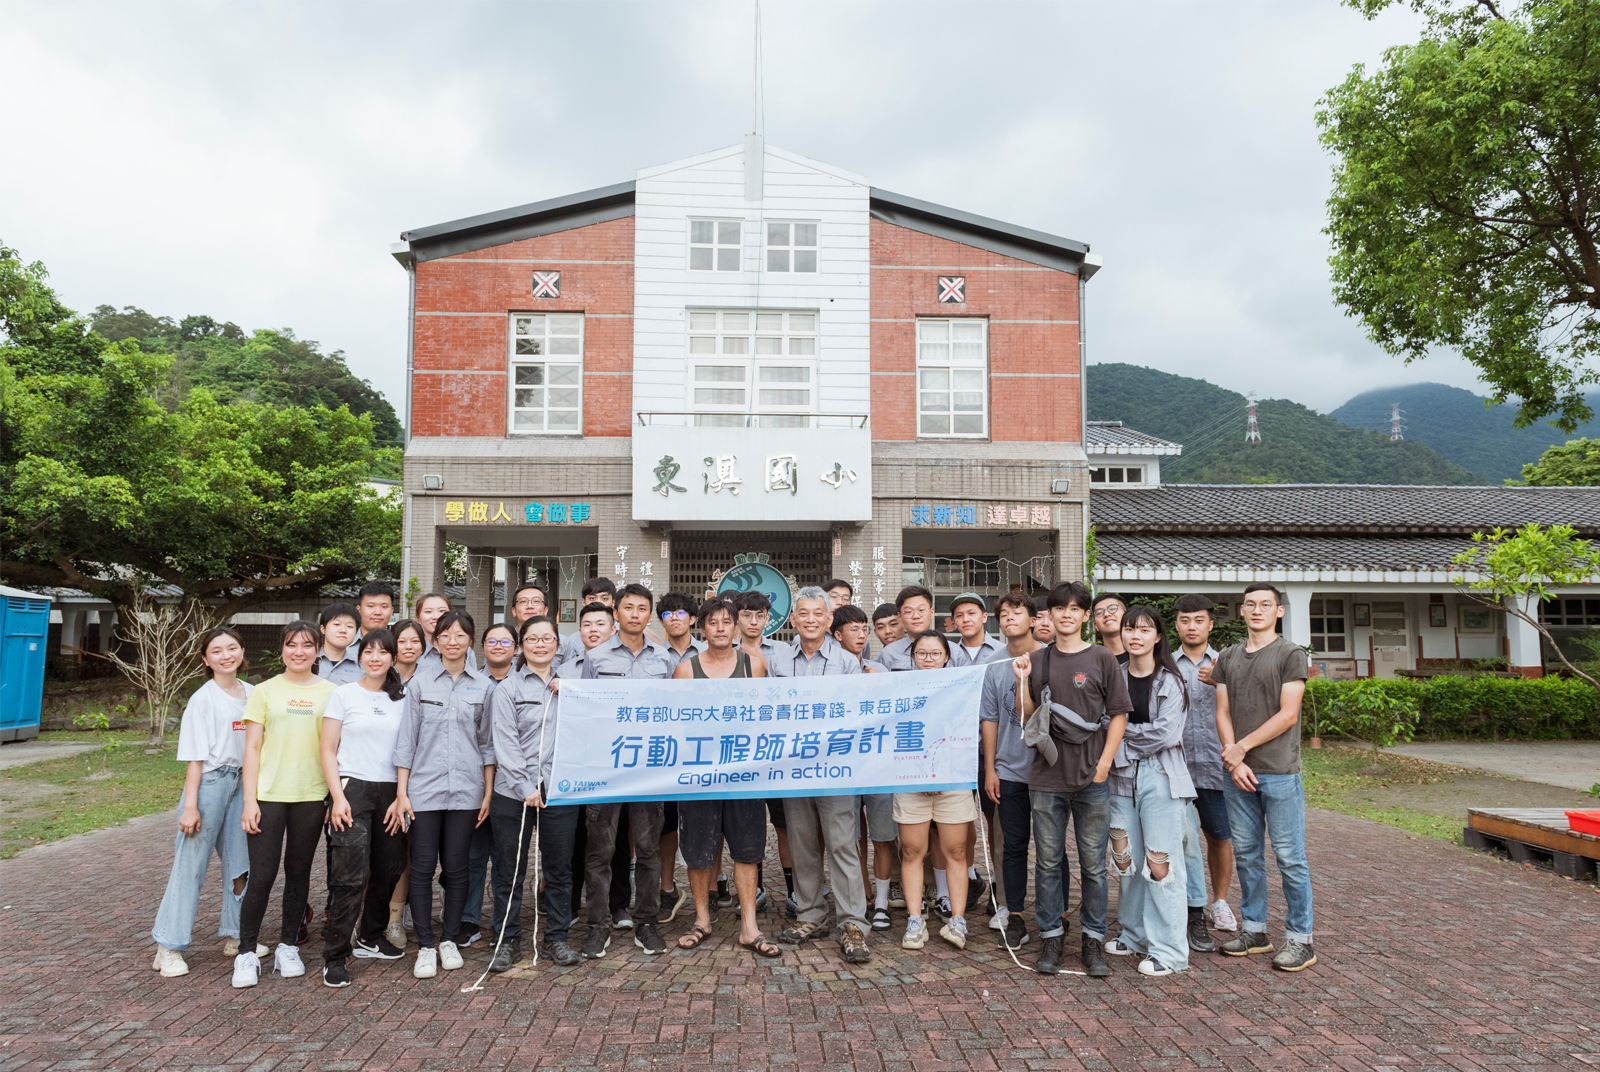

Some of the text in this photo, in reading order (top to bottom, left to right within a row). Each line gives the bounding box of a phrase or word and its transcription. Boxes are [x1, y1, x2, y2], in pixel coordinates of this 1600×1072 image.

[445, 501, 591, 523] 學做人 會做事
[911, 505, 1051, 525] 求新知 達卓越
[858, 696, 928, 716] 東岳部落
[611, 721, 926, 768] 行動工程師培育計畫
[677, 762, 852, 786] Engineer in action
